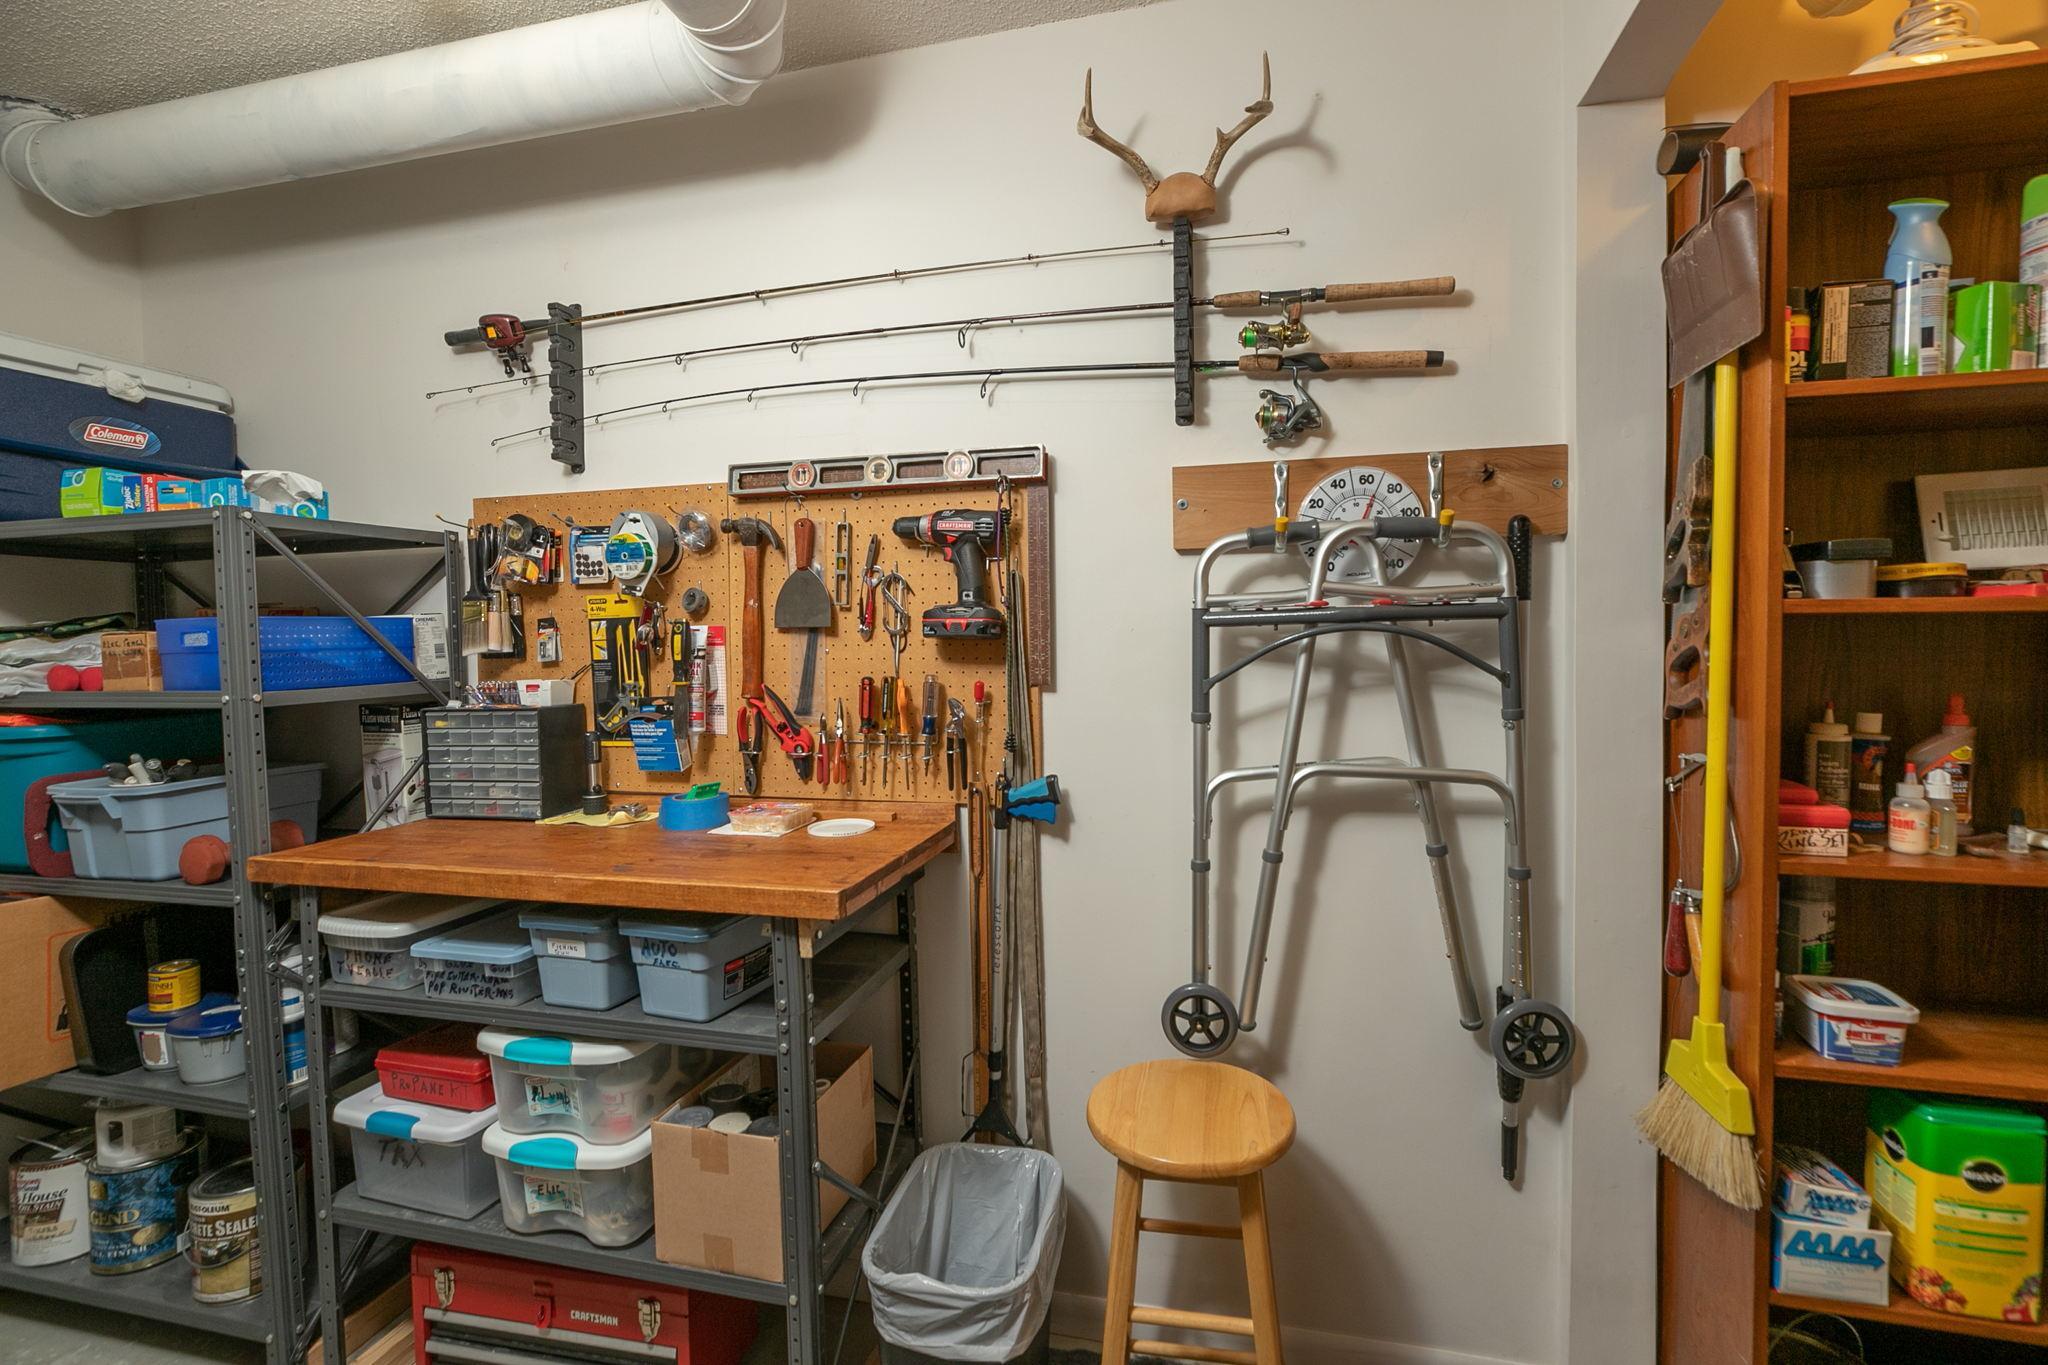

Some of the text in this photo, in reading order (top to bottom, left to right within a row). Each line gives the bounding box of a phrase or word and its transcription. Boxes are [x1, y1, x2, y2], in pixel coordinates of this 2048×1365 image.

[90, 426, 135, 443] Coleman
[1330, 478, 1346, 489] 40
[1359, 474, 1375, 485] 60
[1387, 483, 1402, 494] 80
[1309, 498, 1324, 509] 20
[1400, 507, 1420, 517] 100
[1304, 547, 1316, 557] -2
[1386, 558, 1404, 569] 140
[641, 938, 678, 957] AUTO
[22, 1188, 69, 1202] House
[90, 1209, 140, 1225] GEND
[215, 1215, 257, 1236] SEALE
[570, 1310, 618, 1327] CRAFTSMAN
